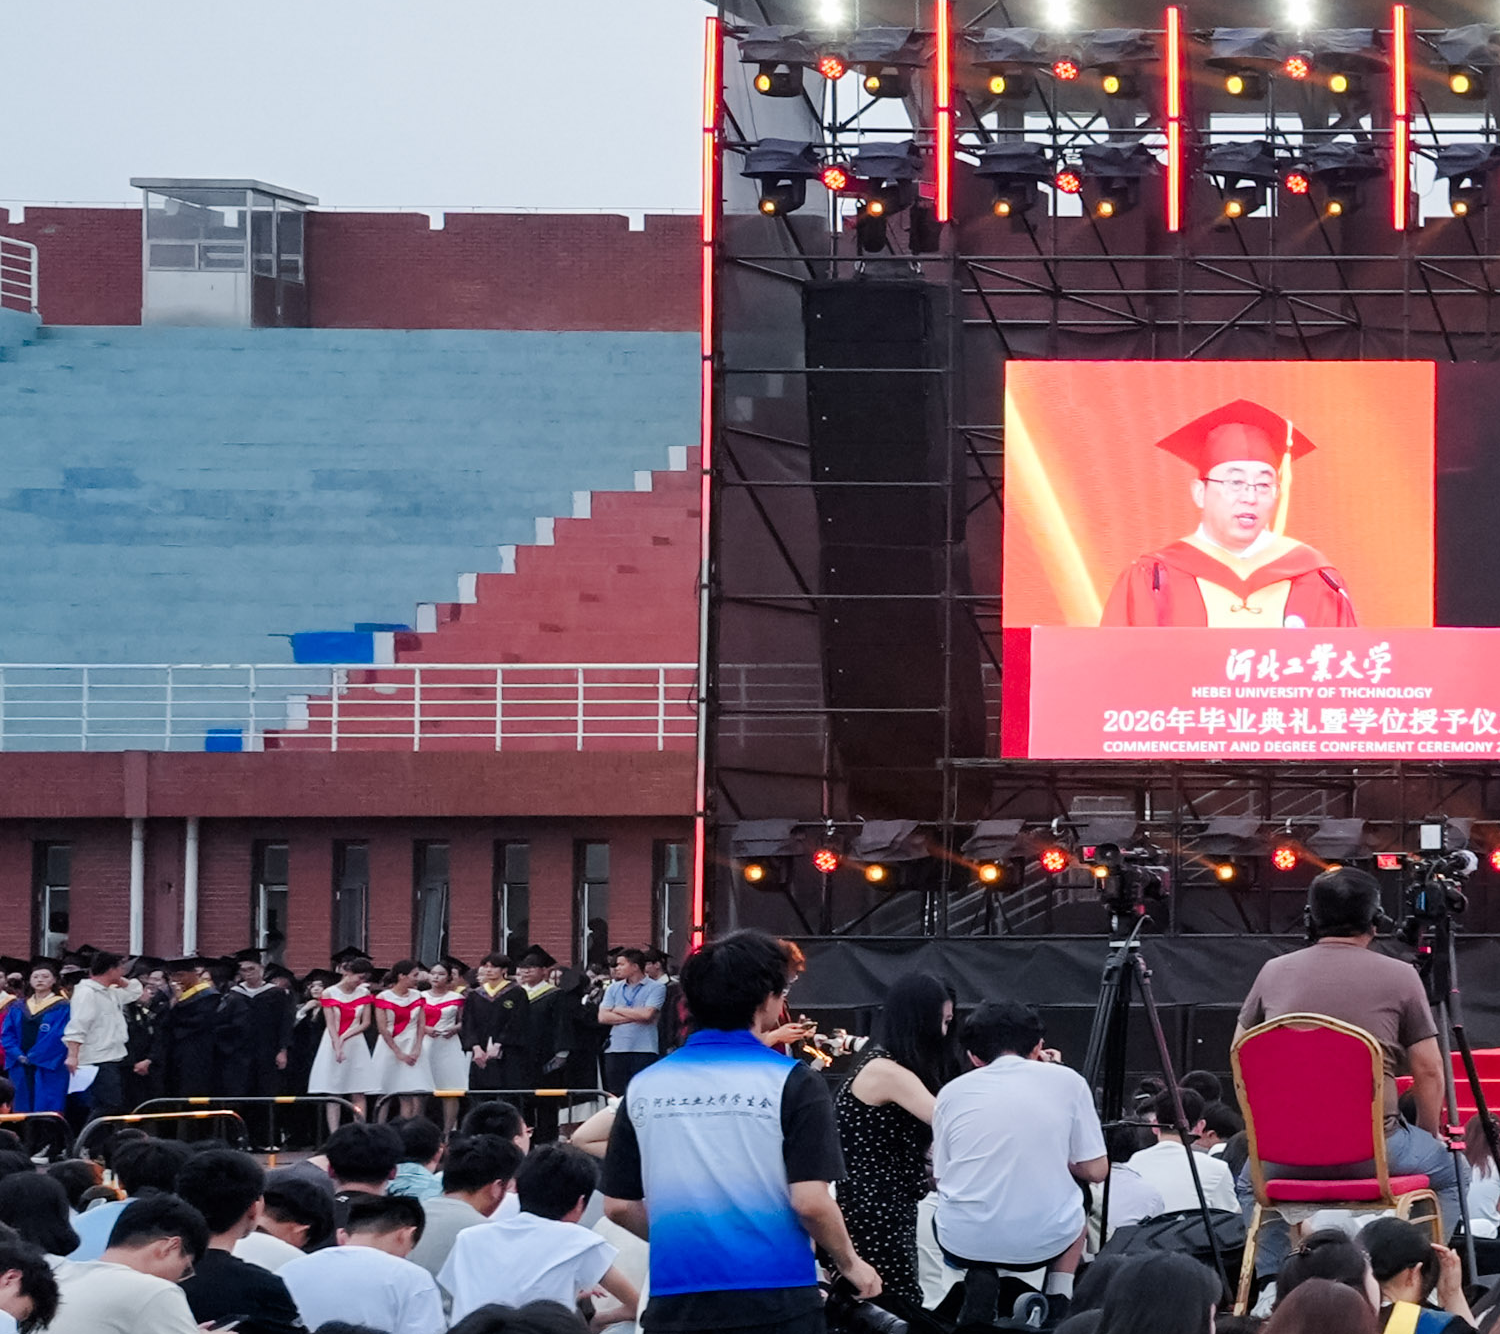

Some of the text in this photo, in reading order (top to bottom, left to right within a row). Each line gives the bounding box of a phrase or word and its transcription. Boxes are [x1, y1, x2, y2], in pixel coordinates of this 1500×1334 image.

[1191, 687, 1232, 698] HEBEI
[1235, 687, 1314, 699] UNIVERSITY
[1317, 687, 1336, 699] OF
[1102, 740, 1227, 753] COMMENCEMENT
[1229, 740, 1261, 753] AND
[1263, 740, 1317, 753] DEGREE
[1319, 740, 1415, 753] CONFERMENT
[1417, 740, 1494, 753] CEREMONY
